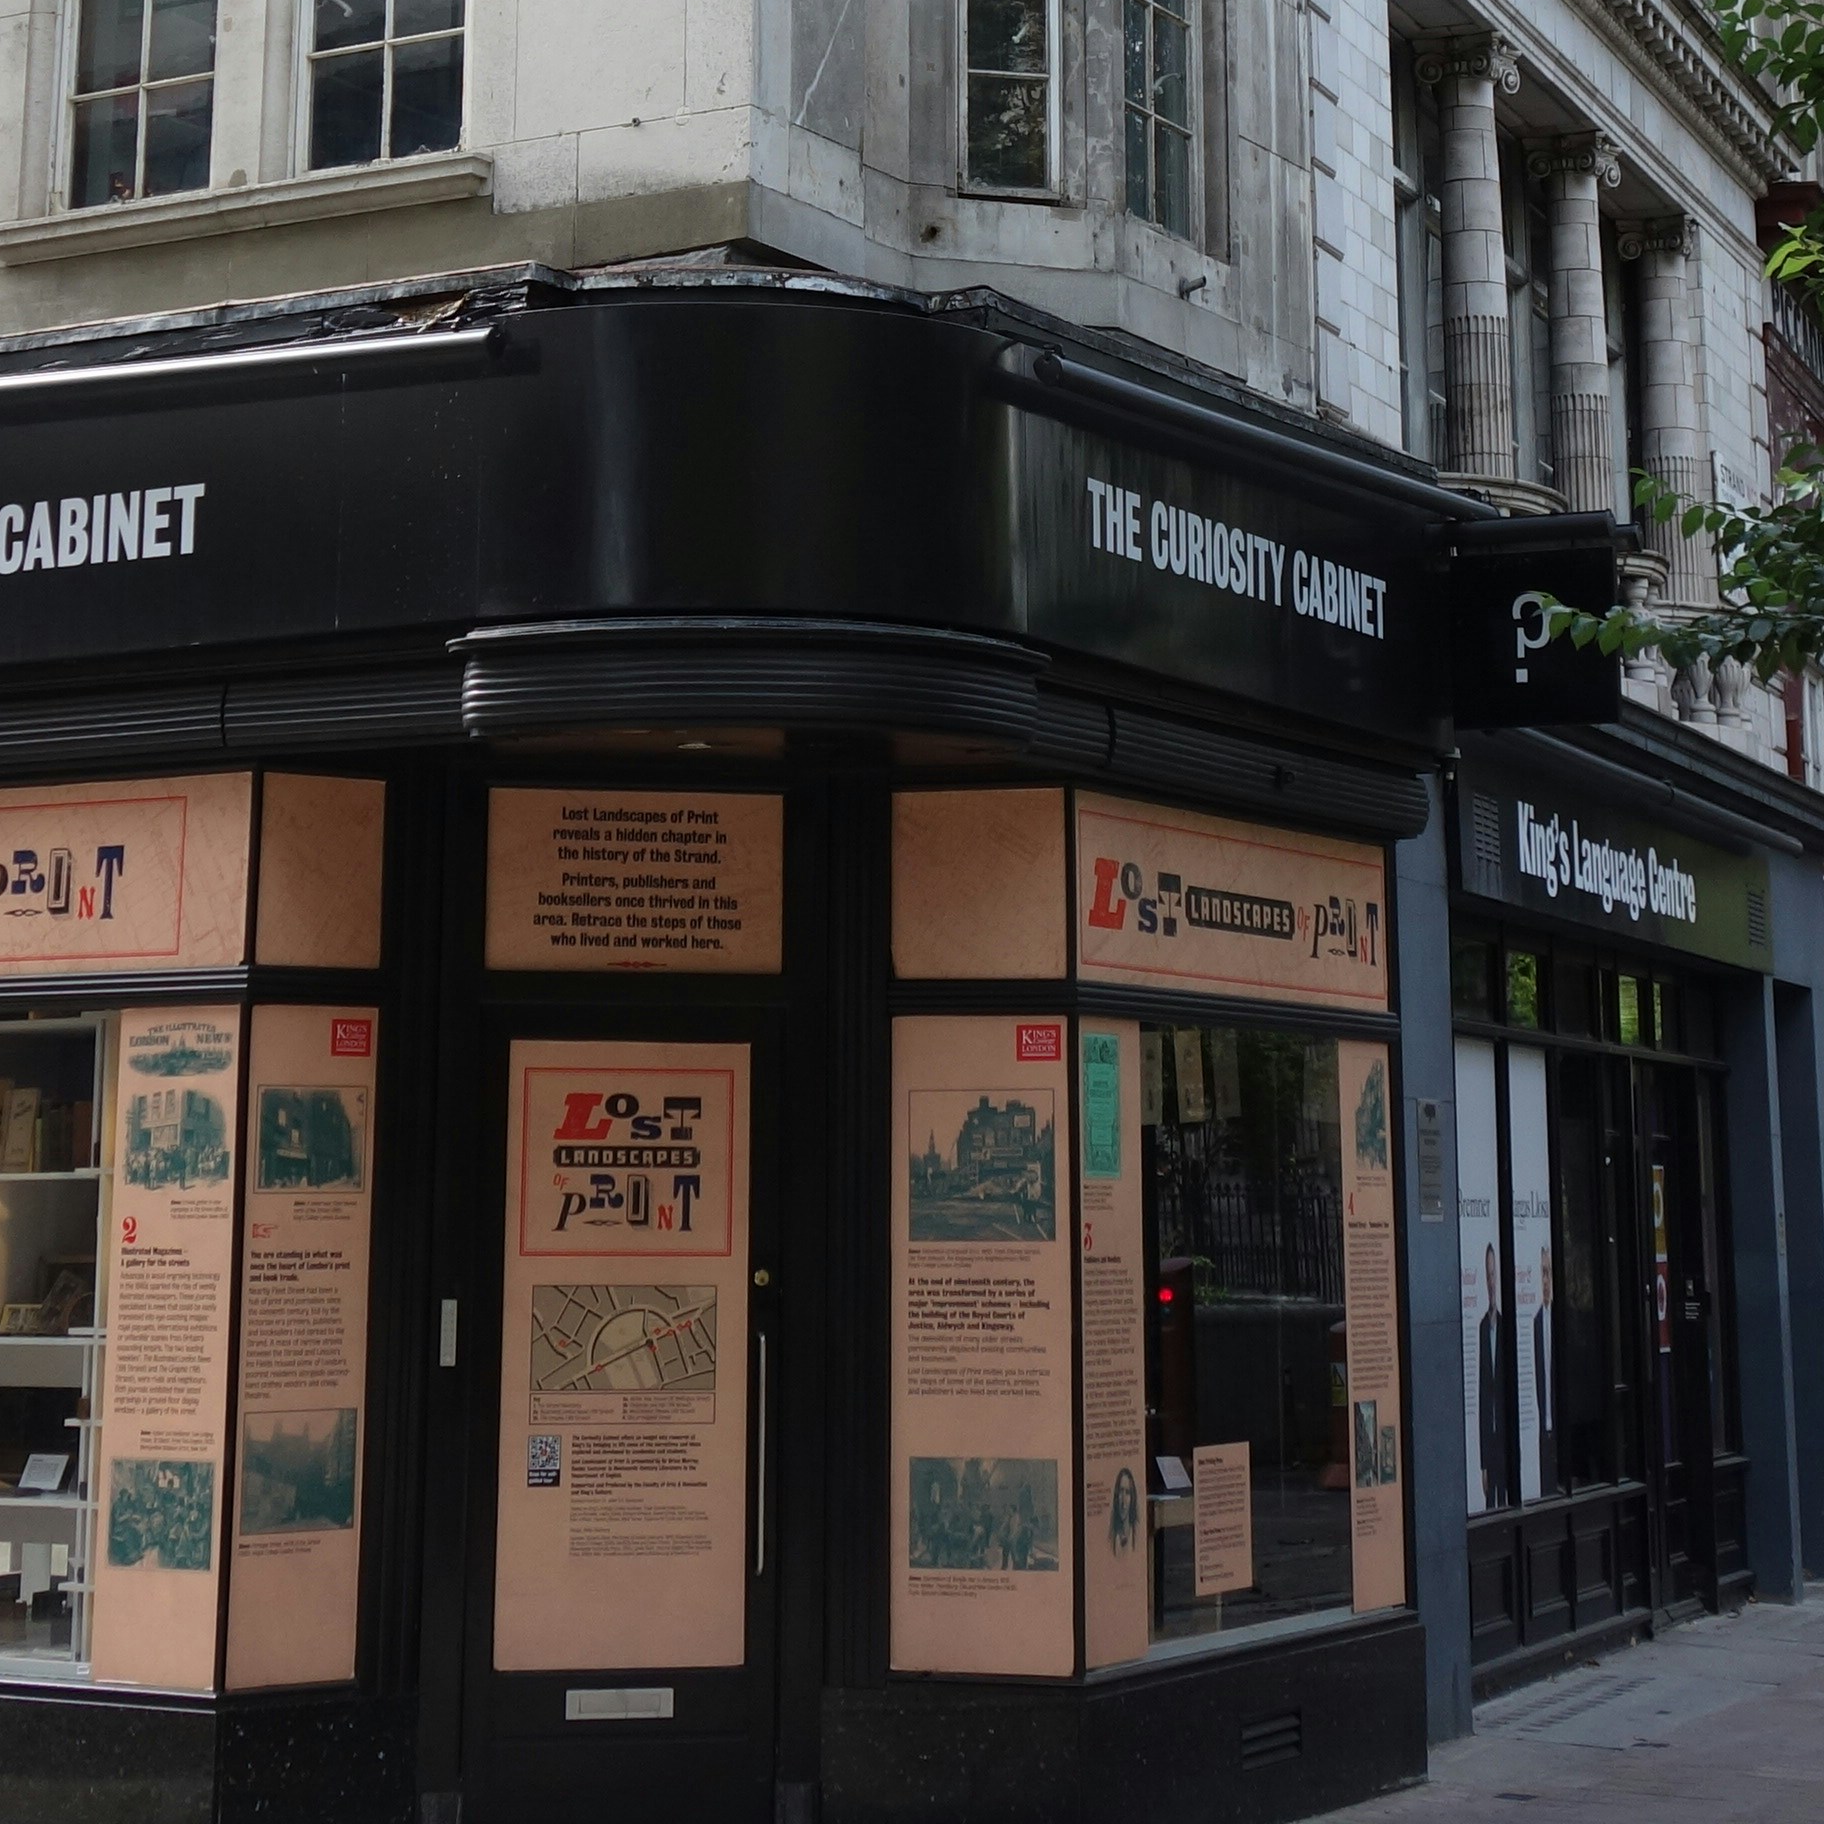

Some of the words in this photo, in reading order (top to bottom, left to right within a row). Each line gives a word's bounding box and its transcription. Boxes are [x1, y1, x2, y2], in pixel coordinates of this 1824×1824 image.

[1087, 477, 1143, 562] THE
[1150, 500, 1286, 608] CURIOSITY
[1292, 549, 1387, 640] CABINET
[562, 806, 588, 822] Lost
[593, 808, 667, 825] Landscapes
[670, 809, 684, 824] of
[687, 810, 719, 825] Print
[553, 829, 600, 842] reveals
[604, 831, 612, 842] a
[616, 829, 657, 843] hidden
[661, 830, 712, 847] chapter
[715, 831, 727, 845] in
[558, 846, 579, 861] the
[583, 847, 629, 864] history
[633, 848, 647, 862] of
[650, 849, 671, 863] the
[674, 850, 722, 864] Strand.
[1517, 800, 1571, 898] King's
[1572, 819, 1647, 922] Language
[1647, 846, 1696, 924] Centre
[562, 873, 619, 890] Printers,
[623, 874, 689, 891] publishers
[692, 875, 716, 890] and
[538, 892, 612, 908] booksellers
[615, 895, 645, 908] once
[649, 894, 695, 910] thrived
[698, 895, 710, 910] in
[713, 896, 738, 911] this
[1088, 857, 1182, 938] LOST
[1190, 893, 1291, 935] LANDSCAPES
[1297, 906, 1311, 942] OF
[1309, 895, 1379, 967] PRINT
[533, 914, 567, 927] area.
[572, 912, 622, 928] Retrace
[626, 914, 648, 928] the
[650, 915, 686, 931] steps
[690, 916, 704, 929] of
[707, 916, 742, 931] those
[551, 933, 576, 946] who
[580, 933, 609, 947] lived
[613, 934, 637, 948] and
[641, 935, 688, 949] worked
[691, 936, 724, 950] here.
[129, 1035, 170, 1047] LONDON
[196, 1032, 232, 1044] NEWS
[1022, 1044, 1056, 1053] LONDON
[553, 1092, 702, 1141] LOST
[560, 1149, 695, 1166] LANDSCAPES
[552, 1173, 569, 1191] OF
[551, 1174, 701, 1232] PRINT
[121, 1216, 137, 1244] 2
[152, 1247, 183, 1257] Magazines
[251, 1251, 261, 1259] You
[276, 1251, 303, 1260] standing
[126, 1259, 145, 1268] gallery
[147, 1258, 156, 1267] for
[157, 1259, 167, 1267] the
[168, 1259, 190, 1267] streets
[267, 1262, 277, 1270] the
[279, 1262, 296, 1270] heart
[298, 1262, 305, 1270] of
[306, 1262, 333, 1270] London's
[335, 1262, 350, 1272] print
[249, 1274, 261, 1282] and
[954, 1278, 990, 1286] nineteenth
[1024, 1278, 1035, 1286] the
[942, 1289, 986, 1297] transformed
[988, 1289, 996, 1298] by
[1005, 1289, 1026, 1297] series
[1028, 1289, 1035, 1297] of
[908, 1300, 928, 1309] major
[981, 1300, 1011, 1308] schemes
[1019, 1300, 1050, 1310] including
[908, 1311, 920, 1319] the
[921, 1311, 948, 1320] building
[949, 1311, 957, 1319] of
[958, 1311, 970, 1319] the
[972, 1311, 991, 1320] Royal
[992, 1311, 1016, 1319] Courts
[1018, 1311, 1025, 1319] of
[908, 1322, 935, 1330] Justice,
[937, 1322, 965, 1331] Aldwych
[967, 1322, 980, 1330] and
[981, 1322, 1015, 1332] Kingsway.
